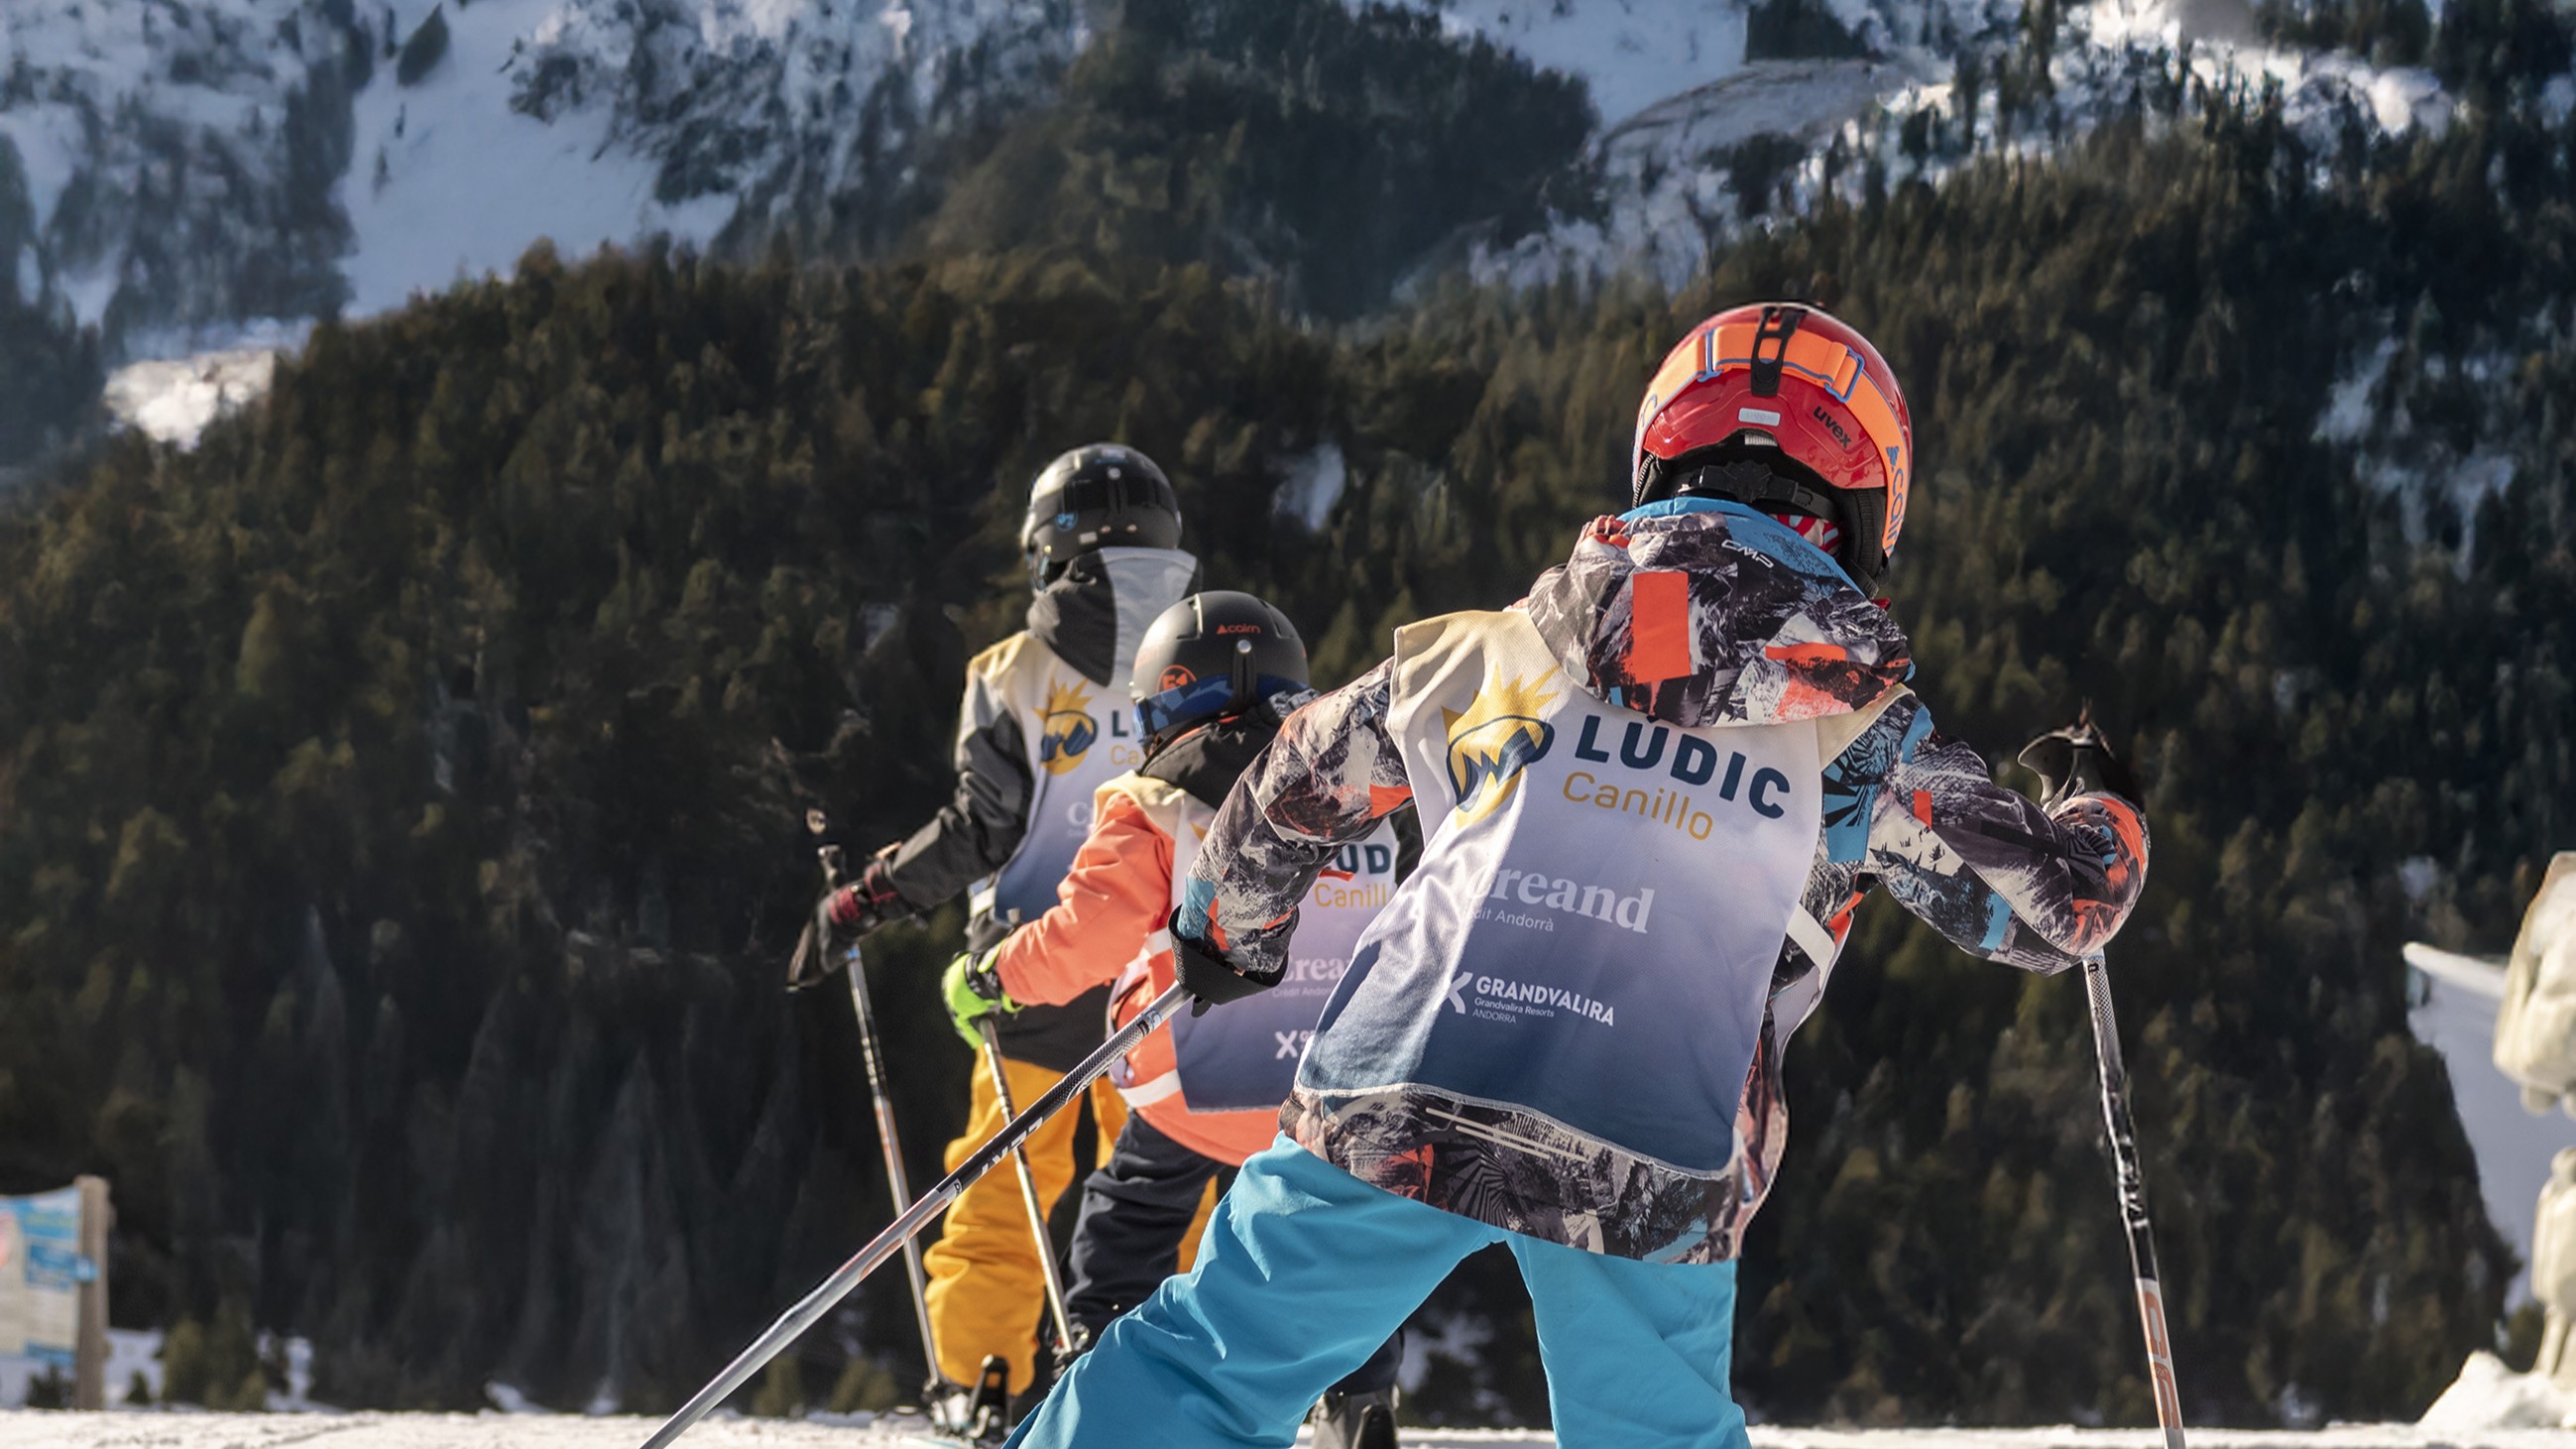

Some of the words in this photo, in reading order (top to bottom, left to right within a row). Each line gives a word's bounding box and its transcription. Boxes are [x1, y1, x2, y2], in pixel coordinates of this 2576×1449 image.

[1813, 405, 1852, 449] uvex
[1720, 540, 1775, 569] CMP
[1563, 771, 1714, 841] Canillo
[1494, 909, 1555, 931] Andorrà
[1473, 996, 1524, 1015] Grandvalira
[1524, 1005, 1556, 1019] Resorts
[1475, 975, 1615, 1027] GRANDVALIRA
[1471, 1008, 1517, 1025] ANDORRA
